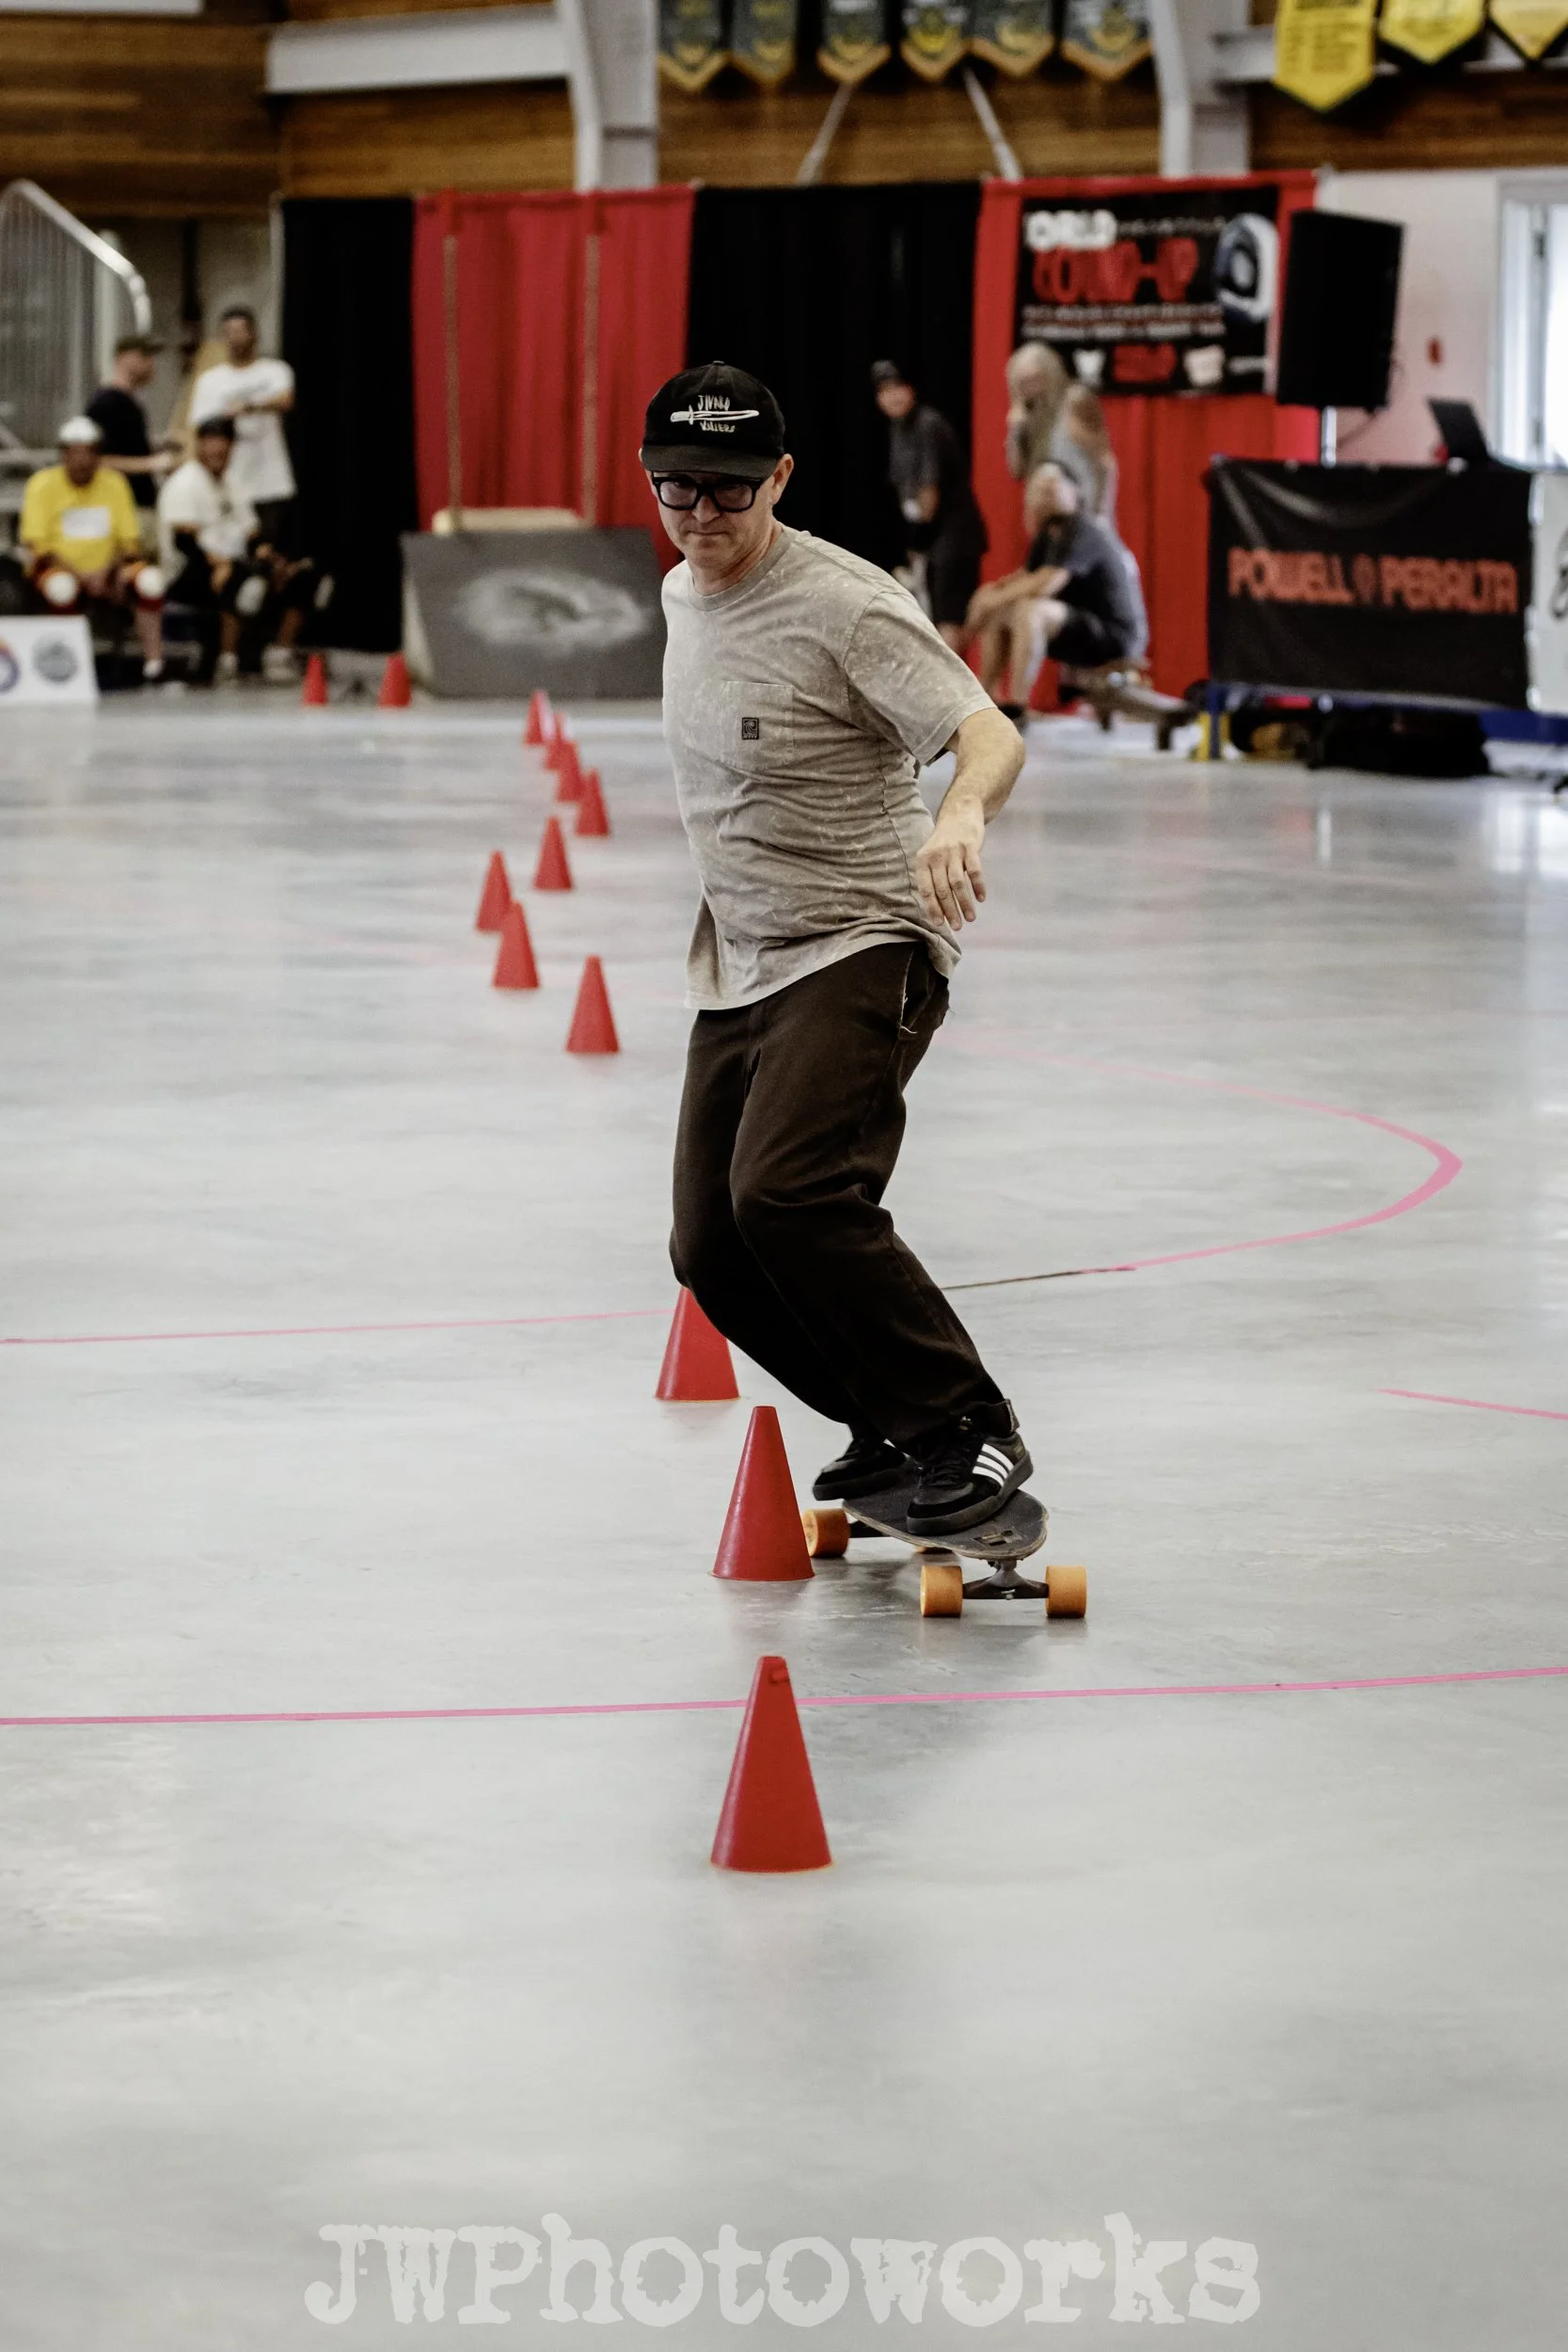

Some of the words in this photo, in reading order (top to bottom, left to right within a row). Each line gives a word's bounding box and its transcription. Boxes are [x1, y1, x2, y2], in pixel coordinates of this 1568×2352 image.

[1023, 209, 1117, 252] ORLD
[1227, 548, 1354, 604] POWELL
[1379, 556, 1517, 613] PERALTA
